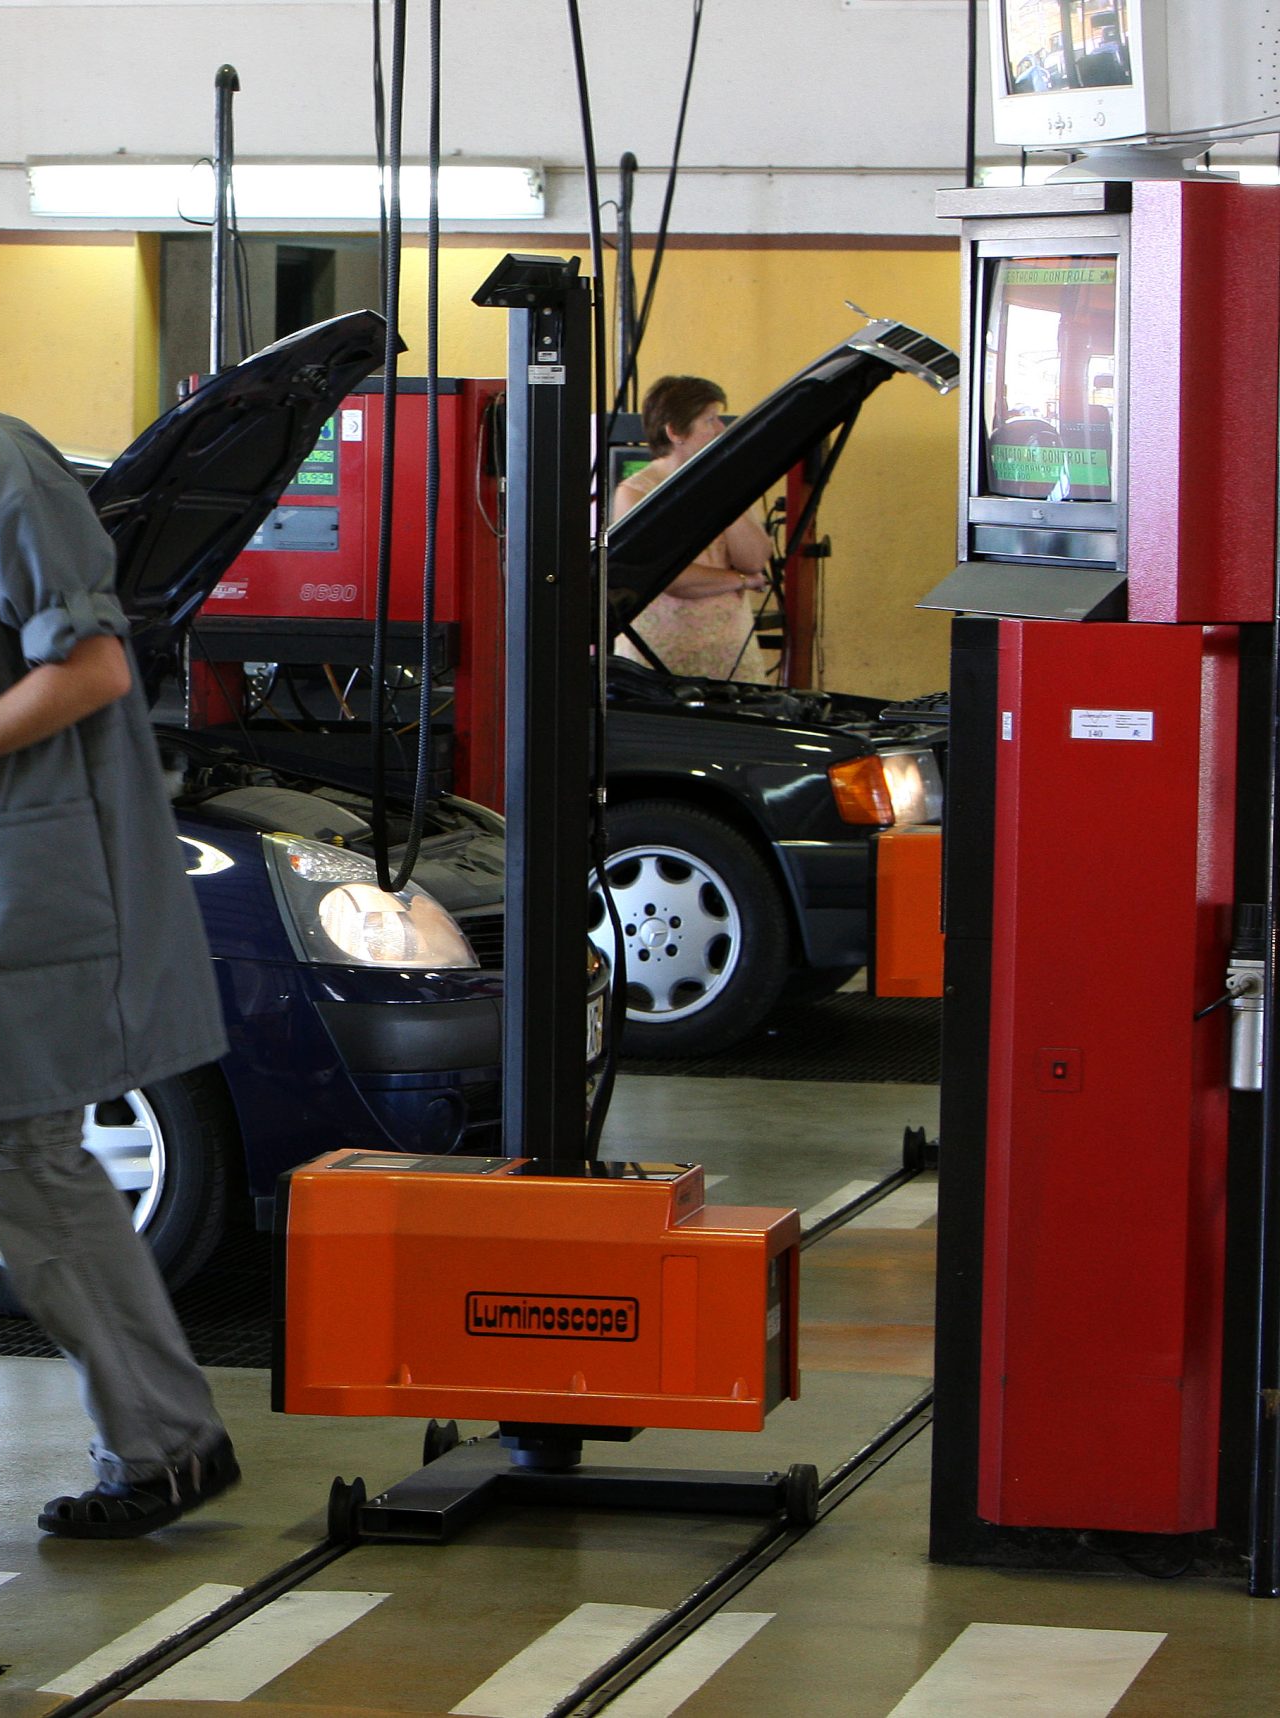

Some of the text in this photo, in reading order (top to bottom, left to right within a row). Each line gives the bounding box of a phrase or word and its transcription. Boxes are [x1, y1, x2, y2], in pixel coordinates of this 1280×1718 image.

[1043, 269, 1094, 283] CONTROLE
[1042, 450, 1097, 466] CONTROLE
[300, 583, 358, 602] 8690
[473, 1298, 628, 1337] Luminoscope
